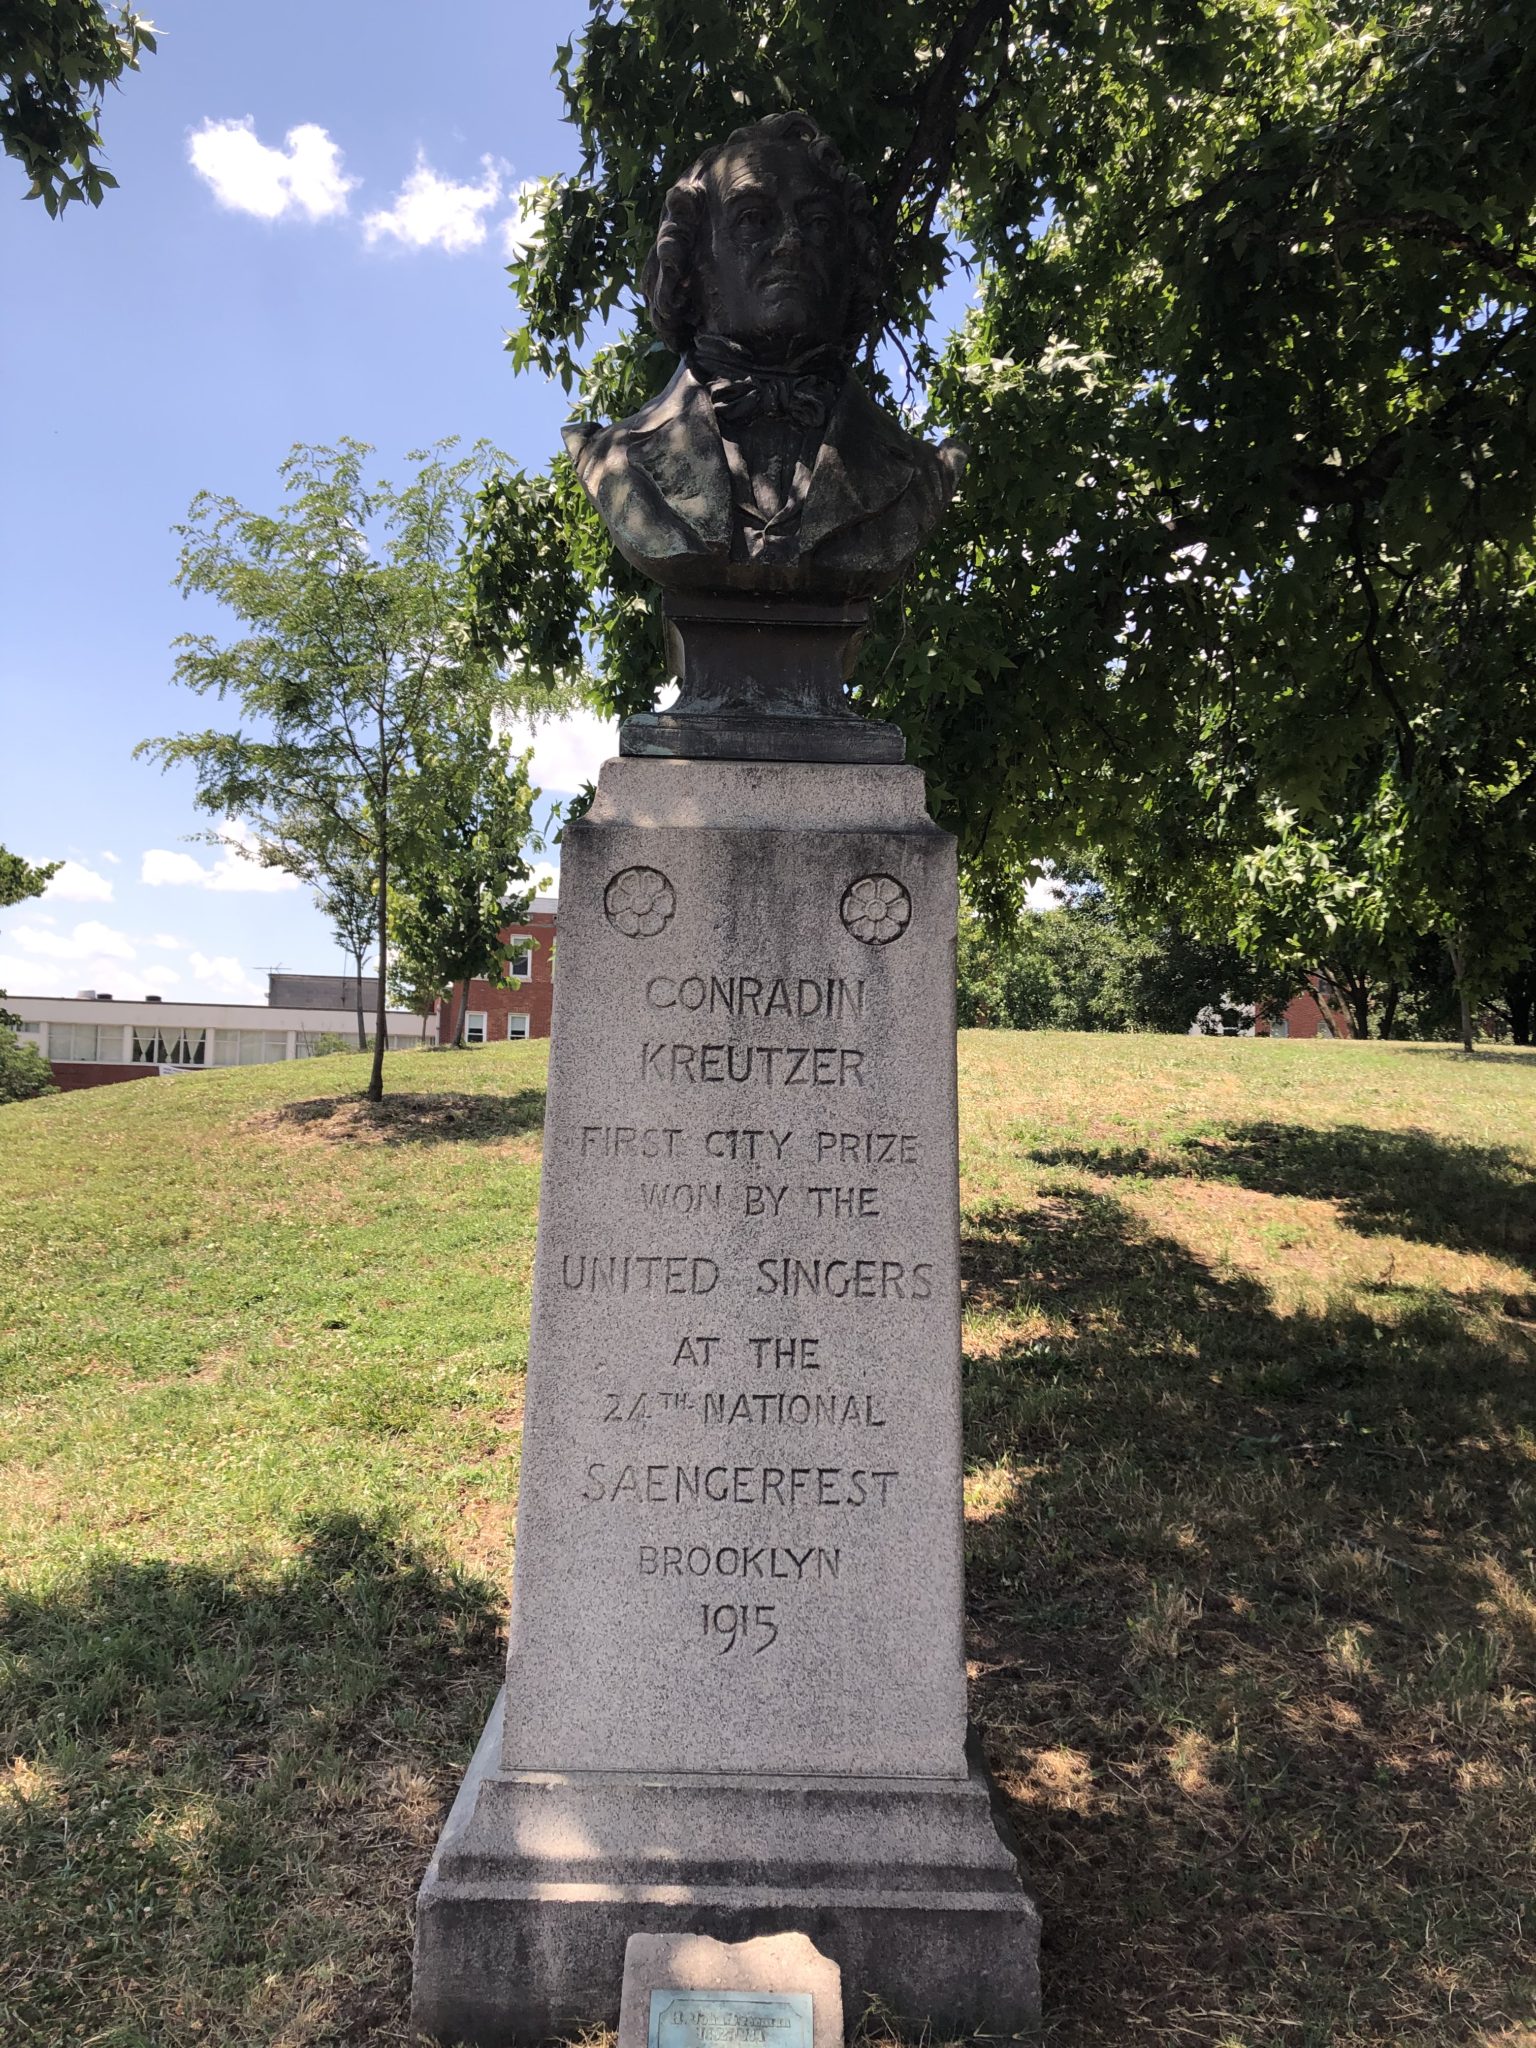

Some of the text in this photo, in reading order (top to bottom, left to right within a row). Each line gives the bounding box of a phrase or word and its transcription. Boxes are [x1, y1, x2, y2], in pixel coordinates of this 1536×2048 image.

[646, 977, 865, 1021] CONRADIN
[641, 1043, 865, 1088] KREUTZER
[580, 1127, 919, 1165] FIRST CITY PRIZE
[640, 1183, 880, 1218] WON BY THE
[562, 1254, 933, 1300] UNITED SINGERS
[672, 1336, 821, 1369] AT THE
[702, 1394, 886, 1427] NATIONAL
[581, 1463, 900, 1506] SAENGERFEST
[639, 1546, 841, 1579] BROOKLYN
[702, 1604, 779, 1656] 1915
